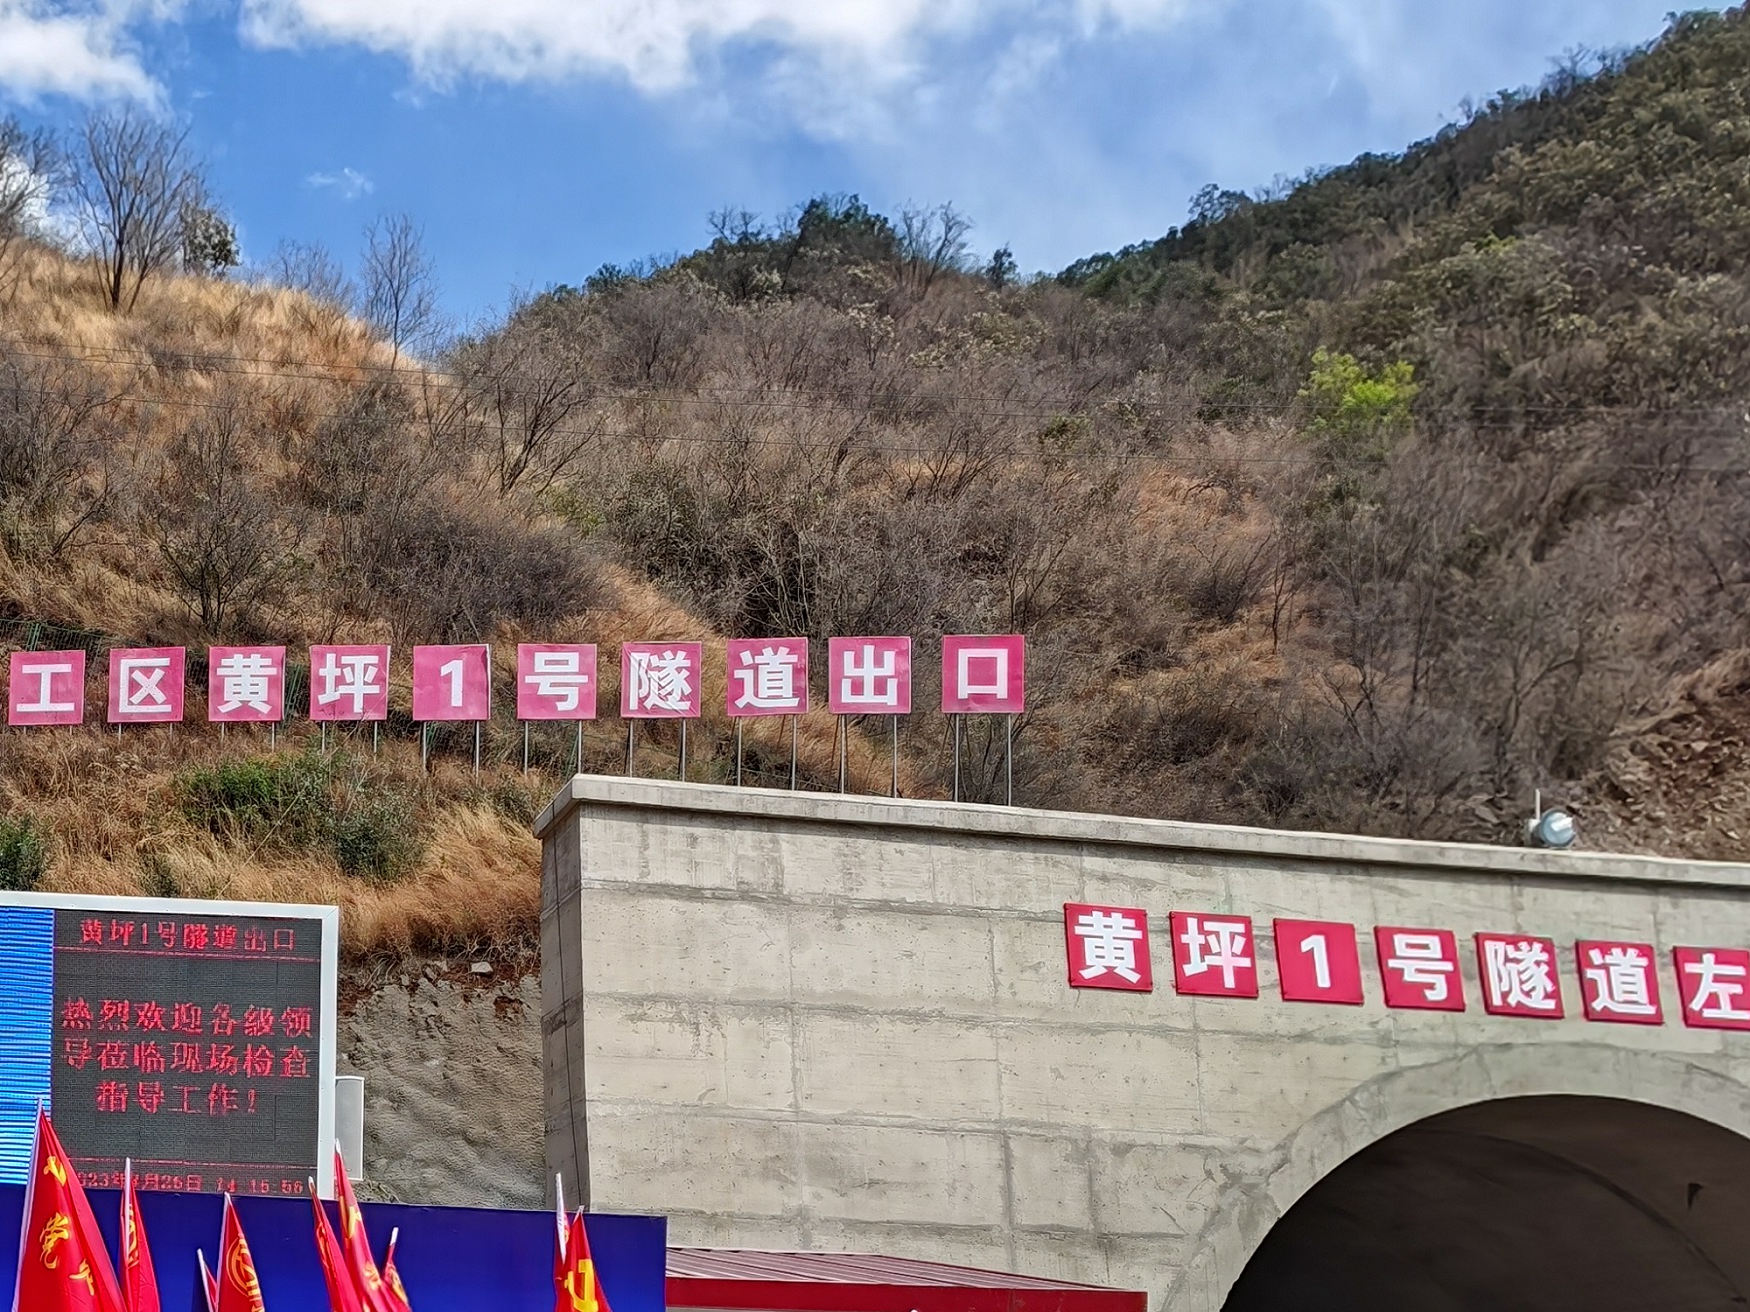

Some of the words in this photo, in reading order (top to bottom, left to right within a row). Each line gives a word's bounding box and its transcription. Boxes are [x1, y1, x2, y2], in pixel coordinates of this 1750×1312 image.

[80, 918, 295, 952] 黄坪1号隧道出口
[1074, 911, 1750, 1019] 黄坪1号隧道左
[61, 999, 314, 1038] 热烈欢迎各级领
[61, 1038, 311, 1079] 导莅临现场检查
